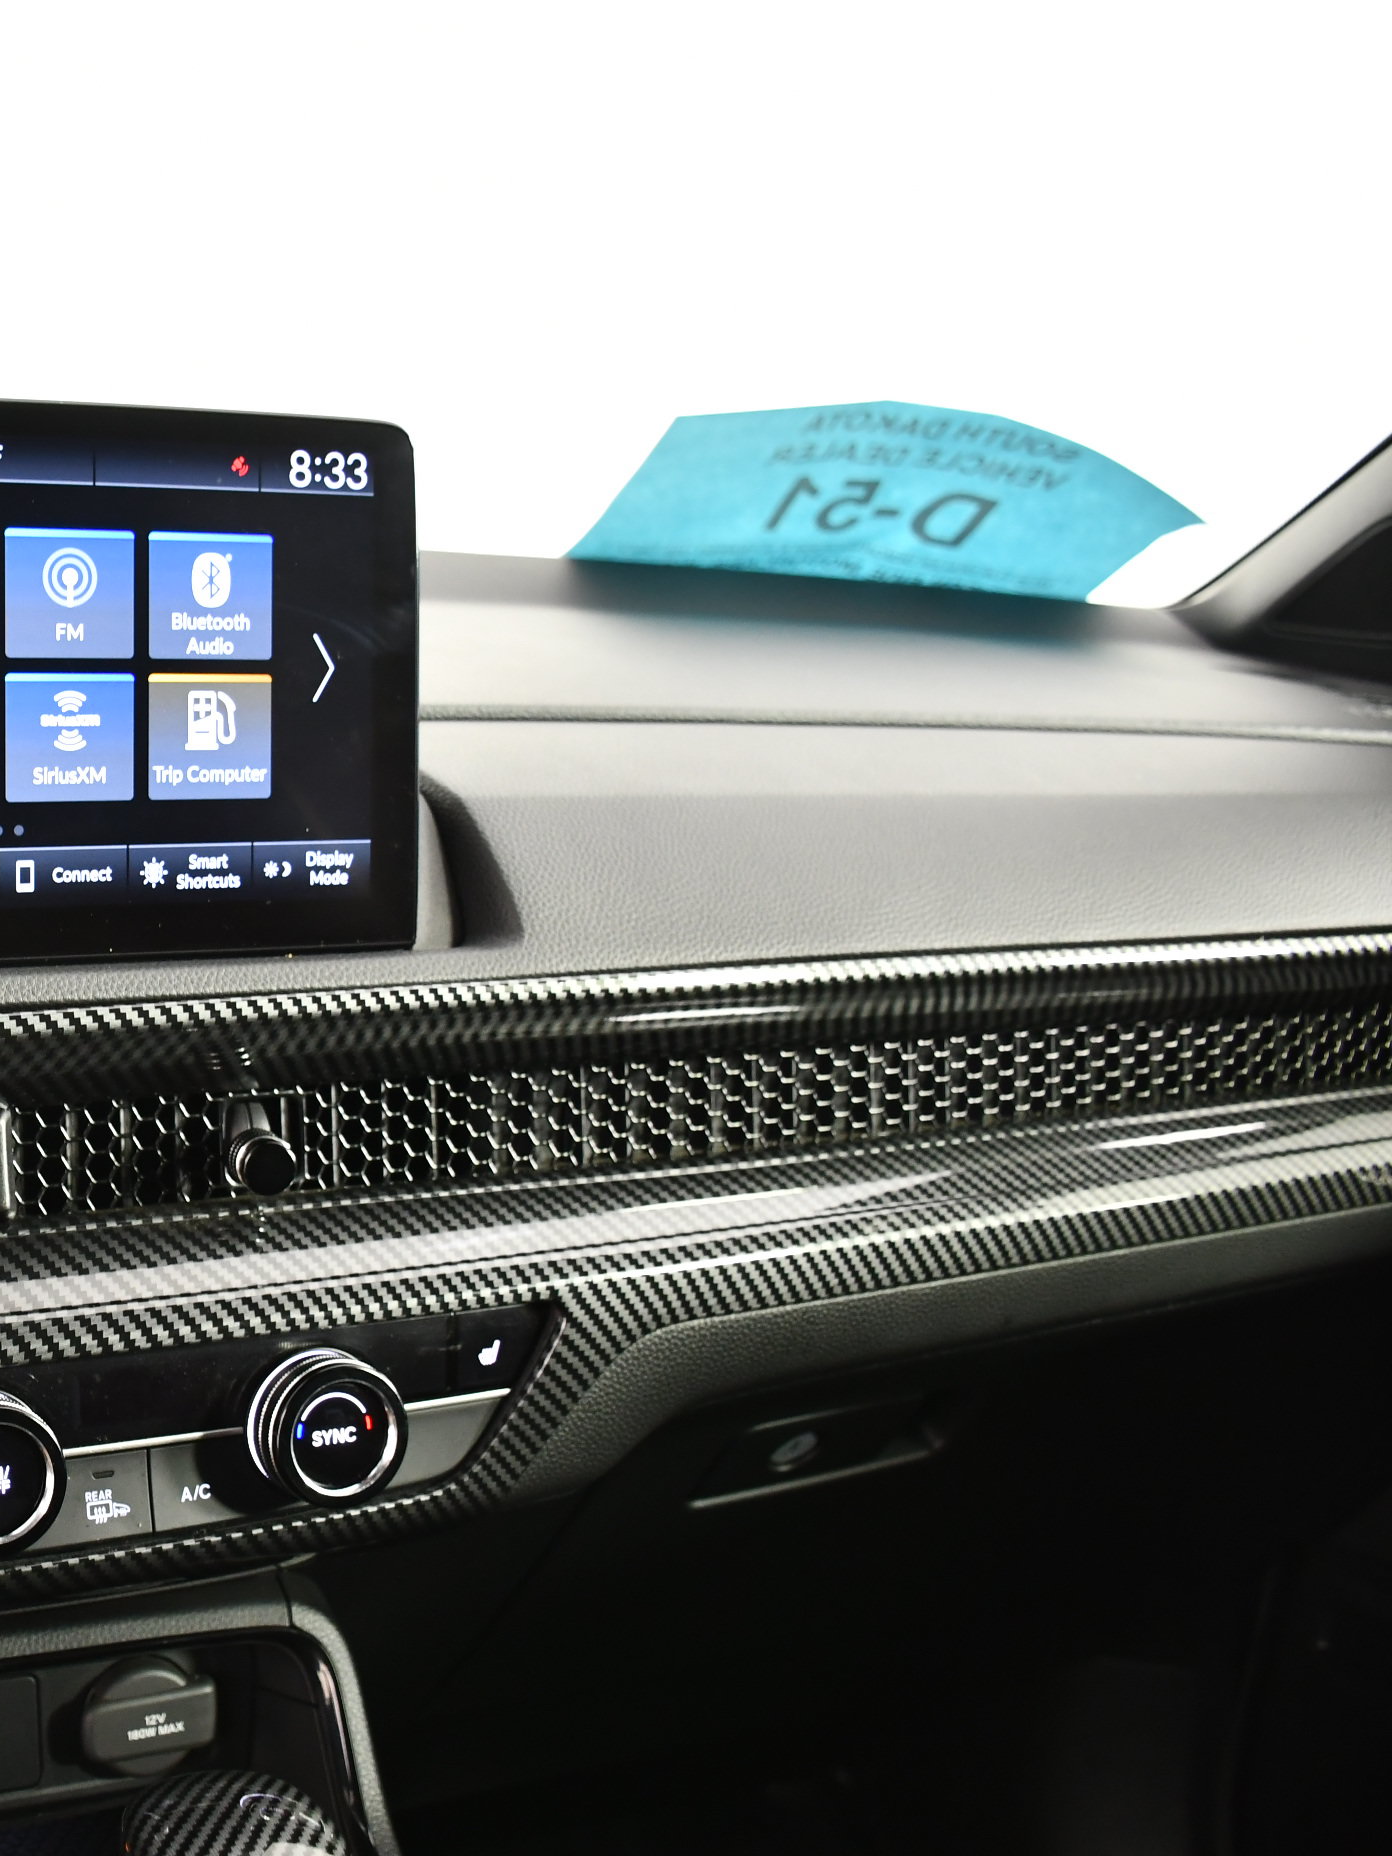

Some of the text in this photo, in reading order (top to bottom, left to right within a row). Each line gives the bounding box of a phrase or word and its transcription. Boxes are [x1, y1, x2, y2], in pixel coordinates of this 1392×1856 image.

[287, 449, 369, 491] 8:33
[171, 612, 251, 632] Bluetooth
[55, 622, 84, 642] FM
[185, 636, 235, 656] Audio
[32, 766, 107, 785] SiriusXM
[152, 765, 268, 787] Trip Computer
[188, 853, 229, 871] Smart
[305, 849, 355, 871] Display
[51, 865, 113, 884] Connect
[175, 872, 242, 891] Shortcuts
[309, 868, 350, 886] Mode
[311, 1425, 357, 1448] SYNC
[84, 1488, 112, 1503] REAR
[181, 1483, 212, 1503] A/C
[144, 1712, 167, 1726] 12V
[157, 1720, 185, 1735] MAX
